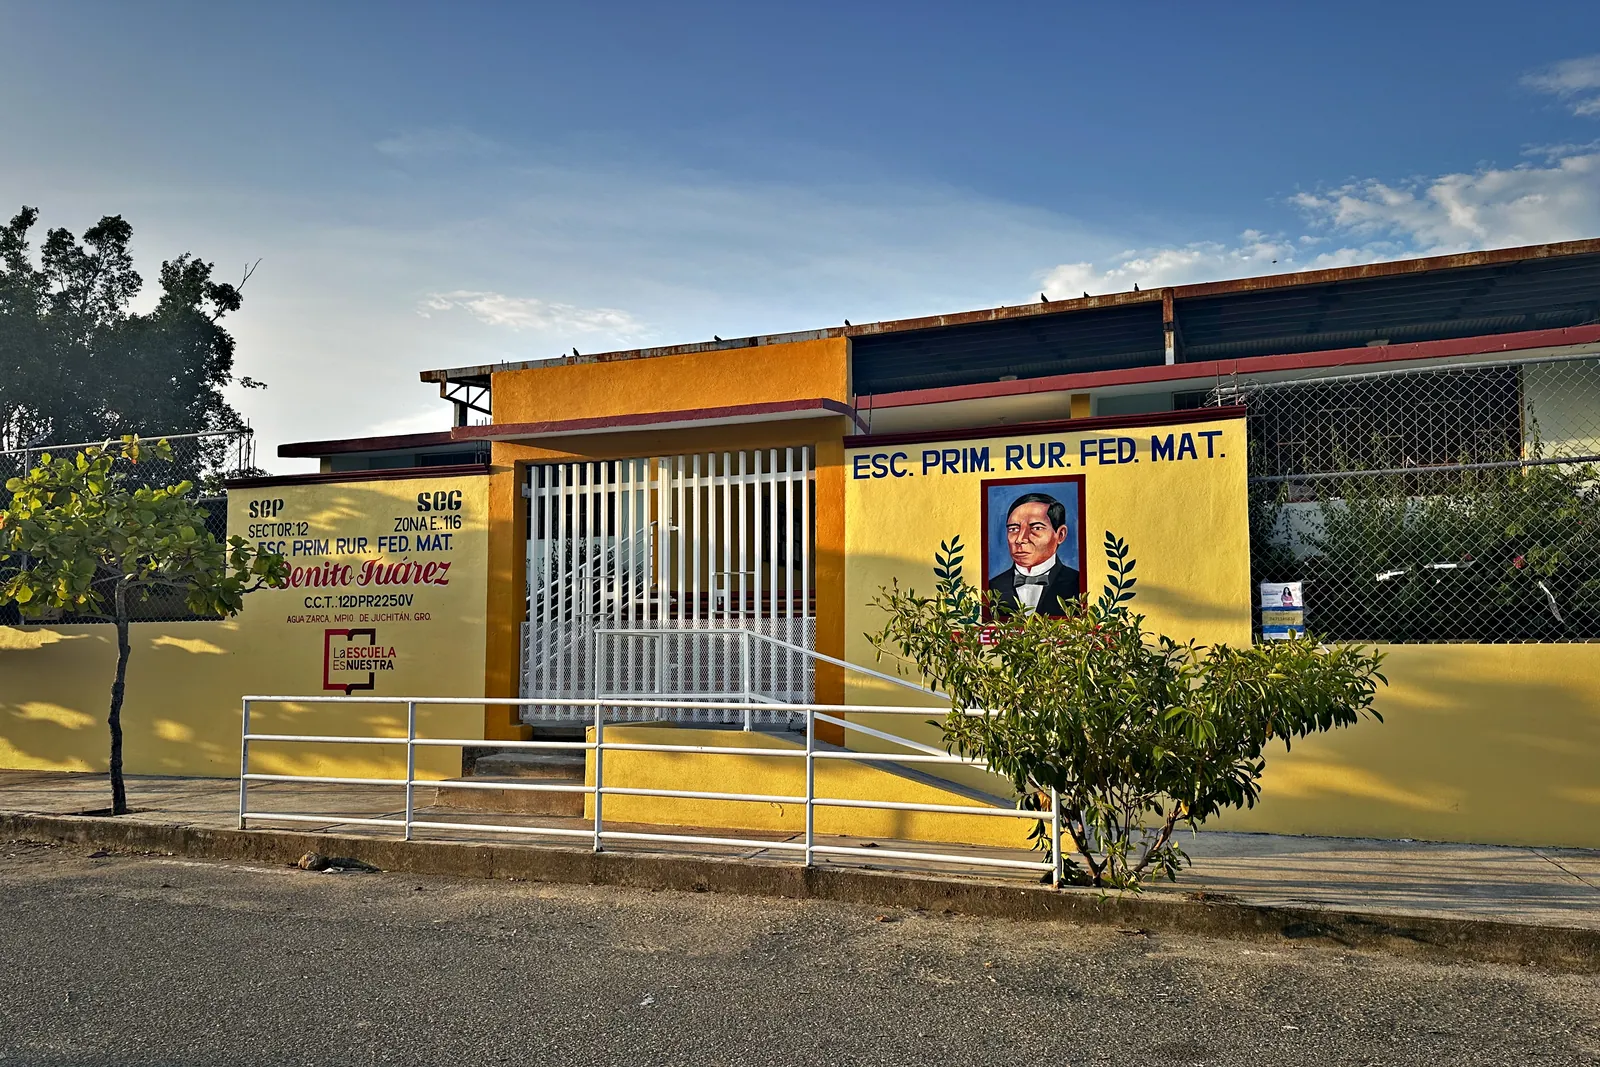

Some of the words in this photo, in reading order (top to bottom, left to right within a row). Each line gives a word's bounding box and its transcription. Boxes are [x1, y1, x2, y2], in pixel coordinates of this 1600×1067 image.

[853, 453, 914, 479] ESC.
[922, 446, 995, 476] PRIM.
[1005, 441, 1071, 471] RUR.
[1080, 436, 1139, 466] FED.
[1152, 430, 1226, 462] MAT.
[394, 516, 428, 532] ZONA
[293, 539, 332, 556] PRIM.
[336, 537, 372, 554] RUR.
[378, 535, 412, 553] FED.
[416, 533, 453, 552] MAT.
[356, 556, 452, 586] Juárez
[359, 613, 369, 622] DE
[414, 612, 432, 621] GRO.
